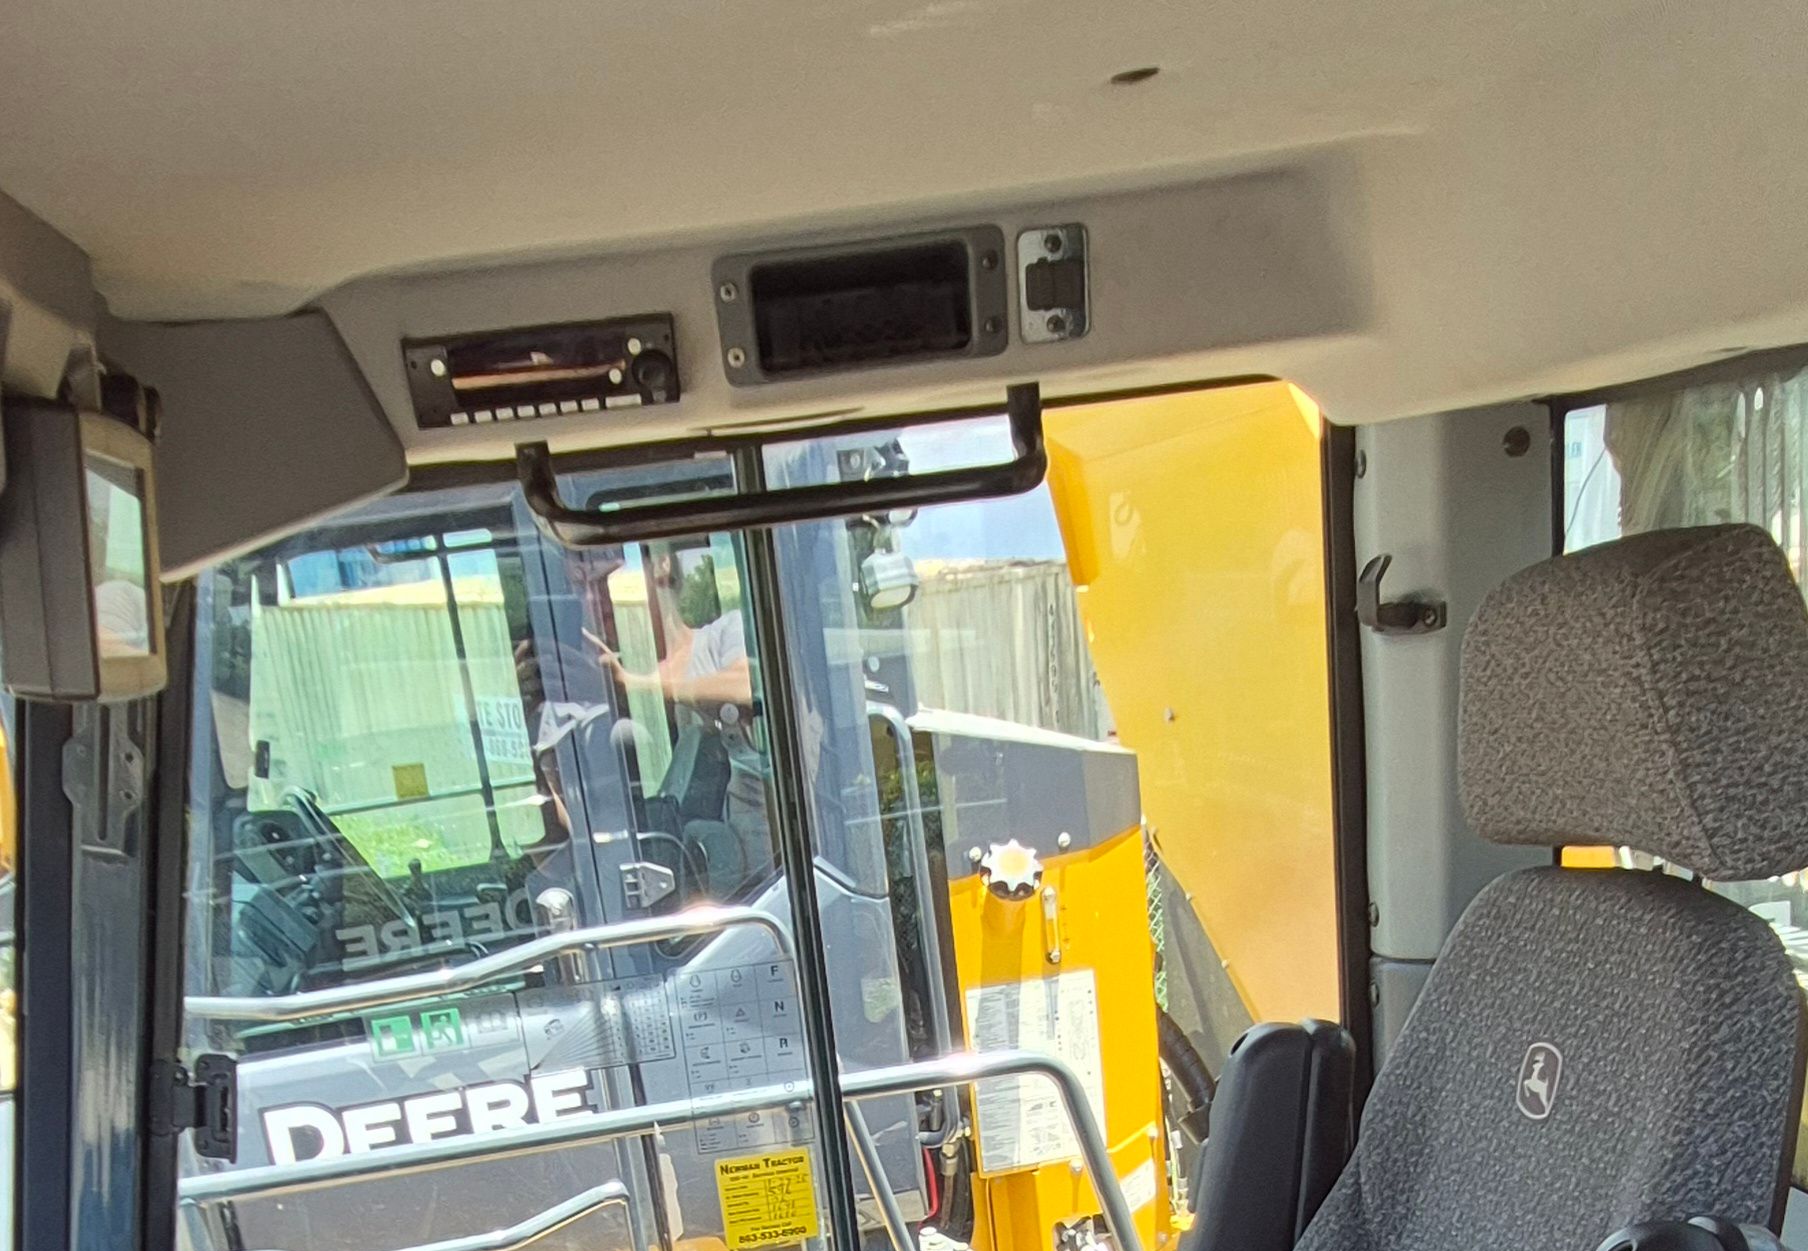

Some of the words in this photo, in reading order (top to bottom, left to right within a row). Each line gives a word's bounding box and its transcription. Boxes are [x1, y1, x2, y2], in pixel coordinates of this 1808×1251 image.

[770, 965, 779, 977] F
[774, 1001, 784, 1013] N
[263, 1066, 596, 1166] DEERE
